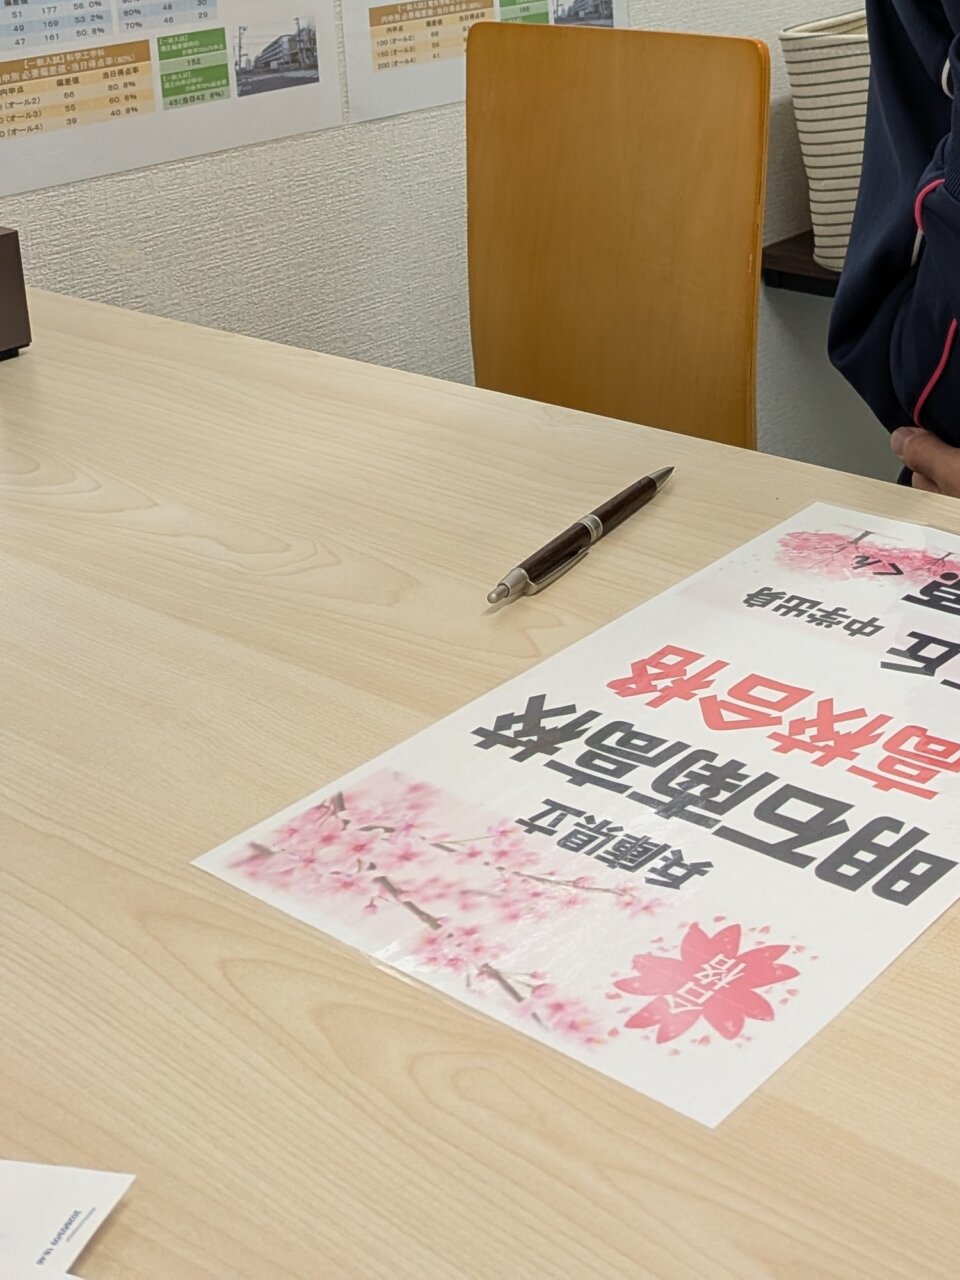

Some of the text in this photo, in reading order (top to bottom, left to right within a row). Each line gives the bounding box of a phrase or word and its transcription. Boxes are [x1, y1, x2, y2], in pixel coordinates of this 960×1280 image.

[42, 6, 57, 14] 177
[13, 24, 24, 32] 49
[14, 38, 26, 46] 47
[56, 76, 79, 87] 偏差値
[102, 67, 139, 79] 当日得点率
[66, 117, 78, 125] 39
[851, 554, 904, 577] くん
[742, 586, 885, 639] 中学出身
[470, 693, 959, 906] 明石南高校
[514, 798, 713, 890] 兵庫県立
[669, 954, 746, 1013] 合格
